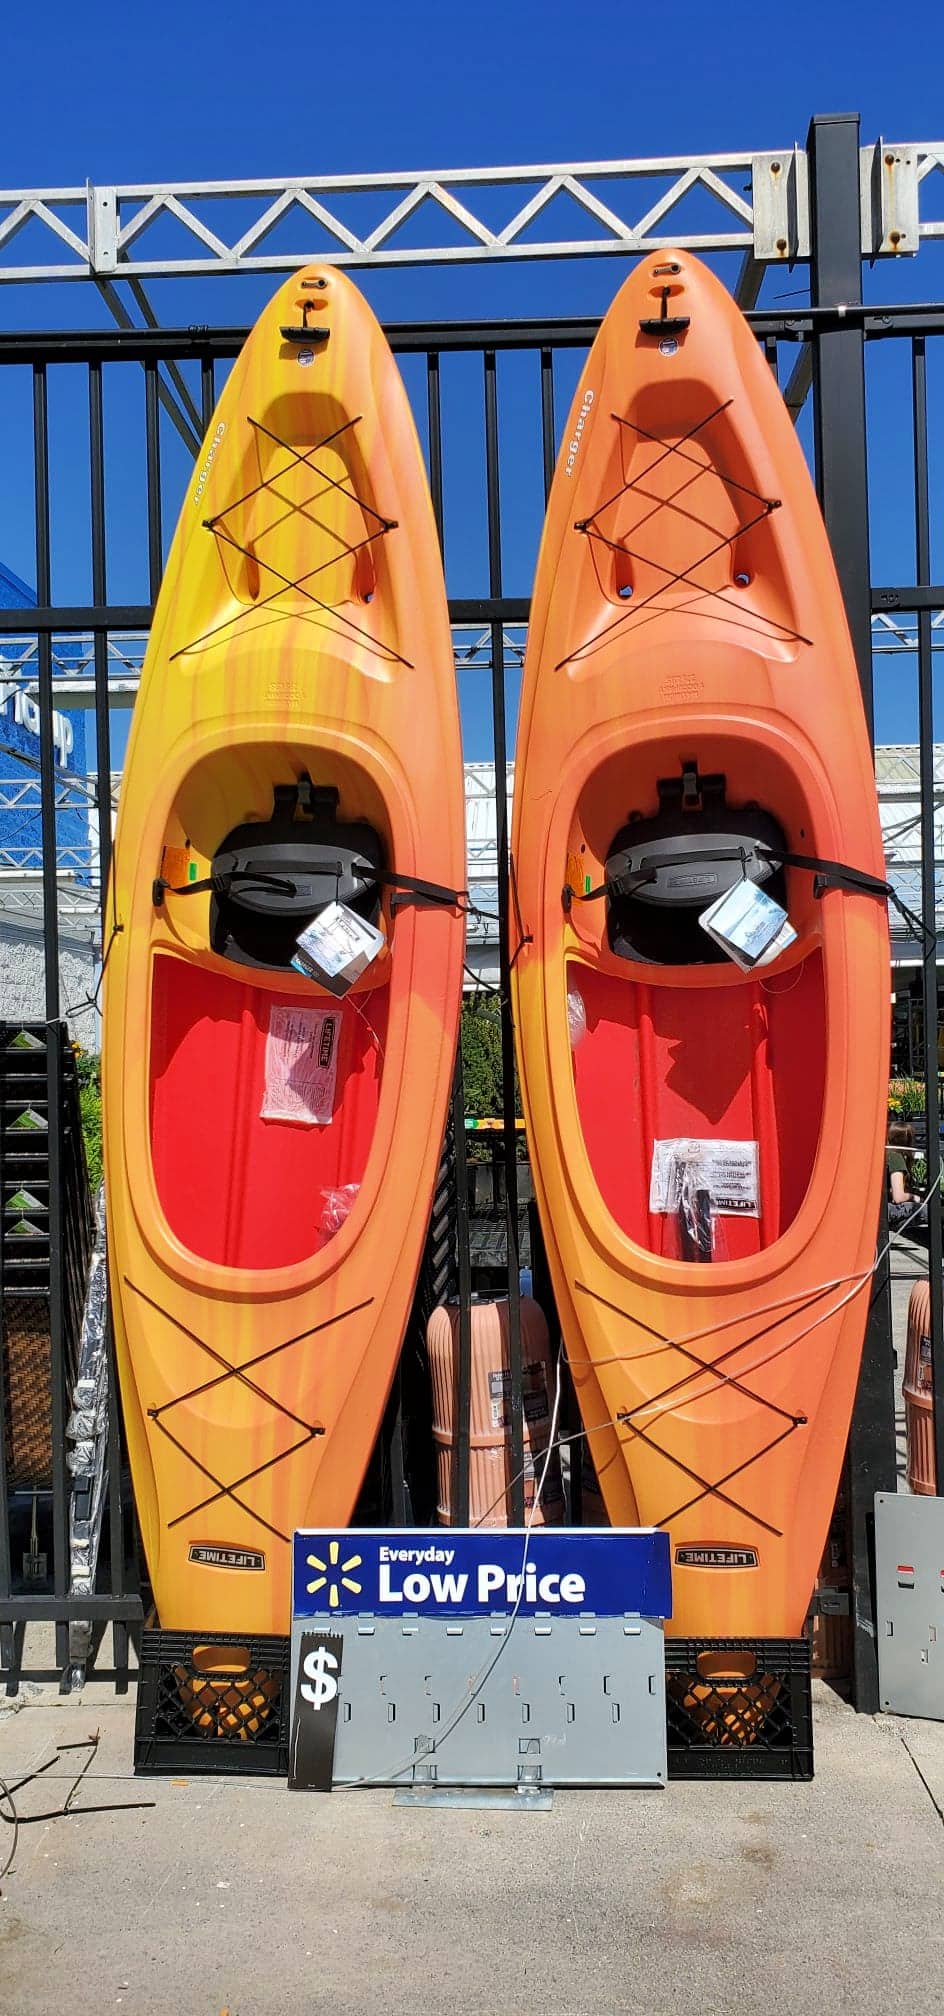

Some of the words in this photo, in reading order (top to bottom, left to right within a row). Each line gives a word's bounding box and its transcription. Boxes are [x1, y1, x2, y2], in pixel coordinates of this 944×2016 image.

[565, 389, 594, 477] Charger
[193, 421, 226, 505] Charger
[198, 1550, 256, 1567] LIFETIME
[379, 1546, 455, 1566] Everyday
[684, 1552, 747, 1564] LIFETIME
[378, 1564, 469, 1603] Low
[477, 1563, 586, 1603] Price
[300, 1646, 338, 1710] $
